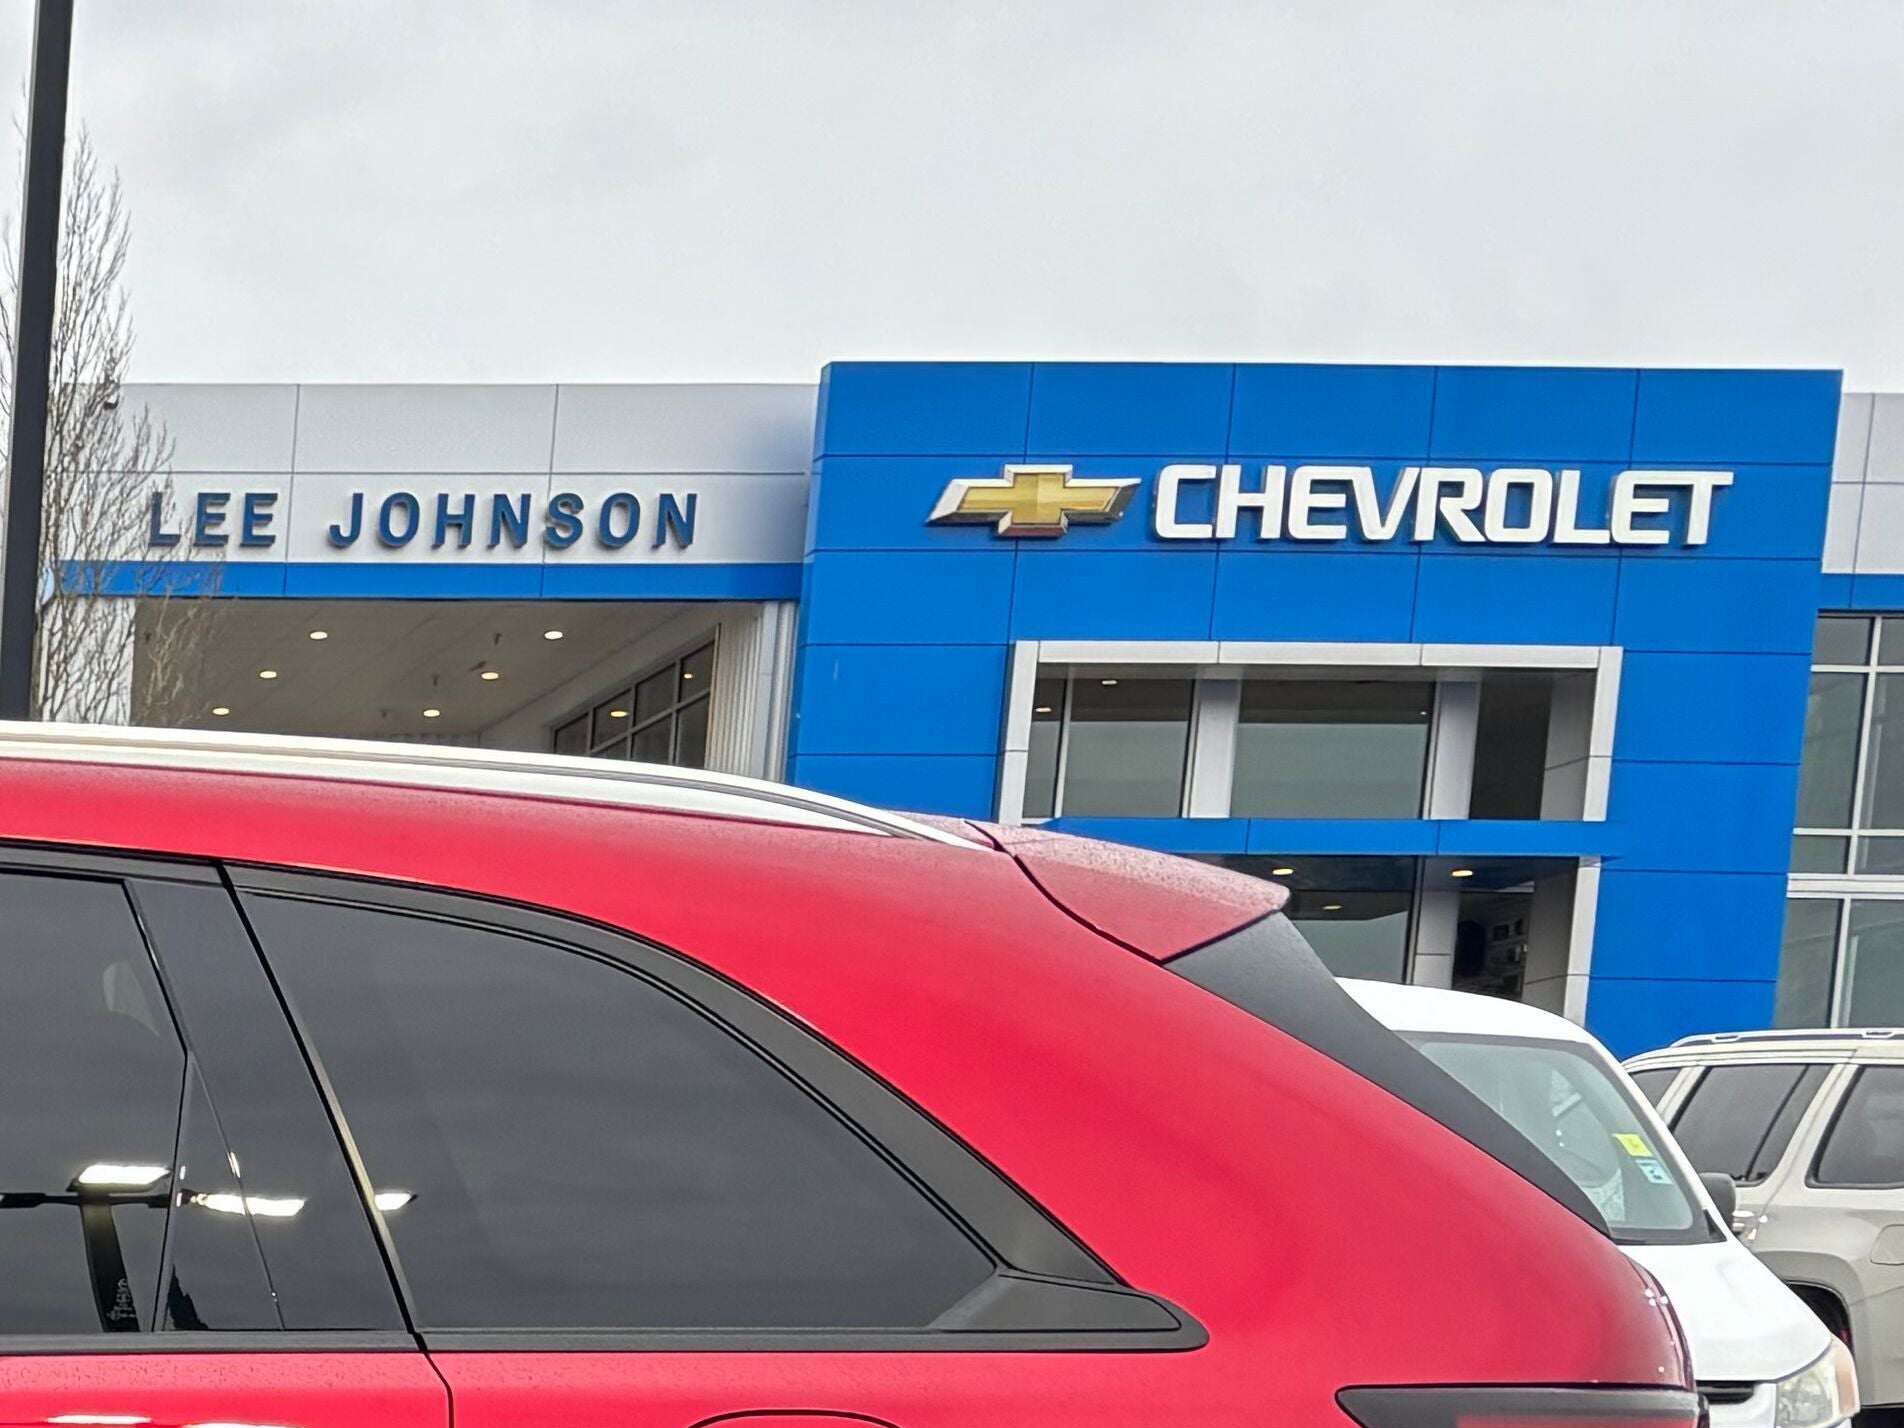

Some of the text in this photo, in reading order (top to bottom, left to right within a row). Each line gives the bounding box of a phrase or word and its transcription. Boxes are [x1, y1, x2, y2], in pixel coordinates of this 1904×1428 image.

[148, 491, 699, 551] LEE JOHNSON
[1153, 464, 1735, 546] CHEVROLET
